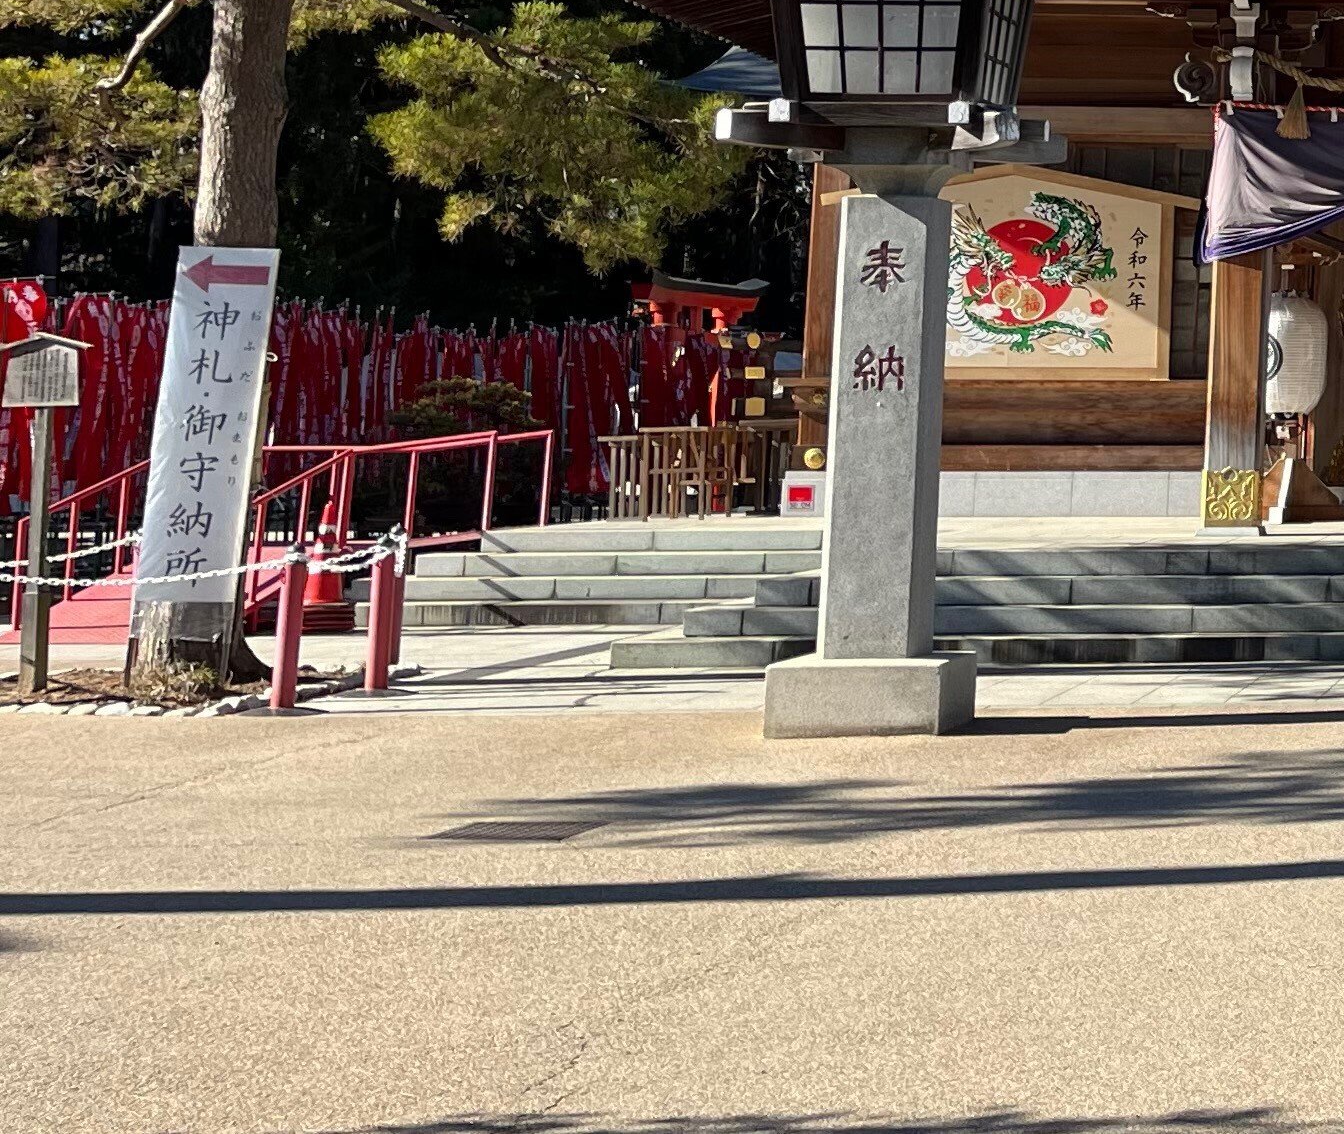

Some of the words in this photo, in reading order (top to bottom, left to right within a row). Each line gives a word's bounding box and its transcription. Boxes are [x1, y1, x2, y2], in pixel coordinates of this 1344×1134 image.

[852, 239, 906, 392] 奉納
[1126, 226, 1149, 311] 令和六年
[164, 300, 241, 588] 神札・御守納所
